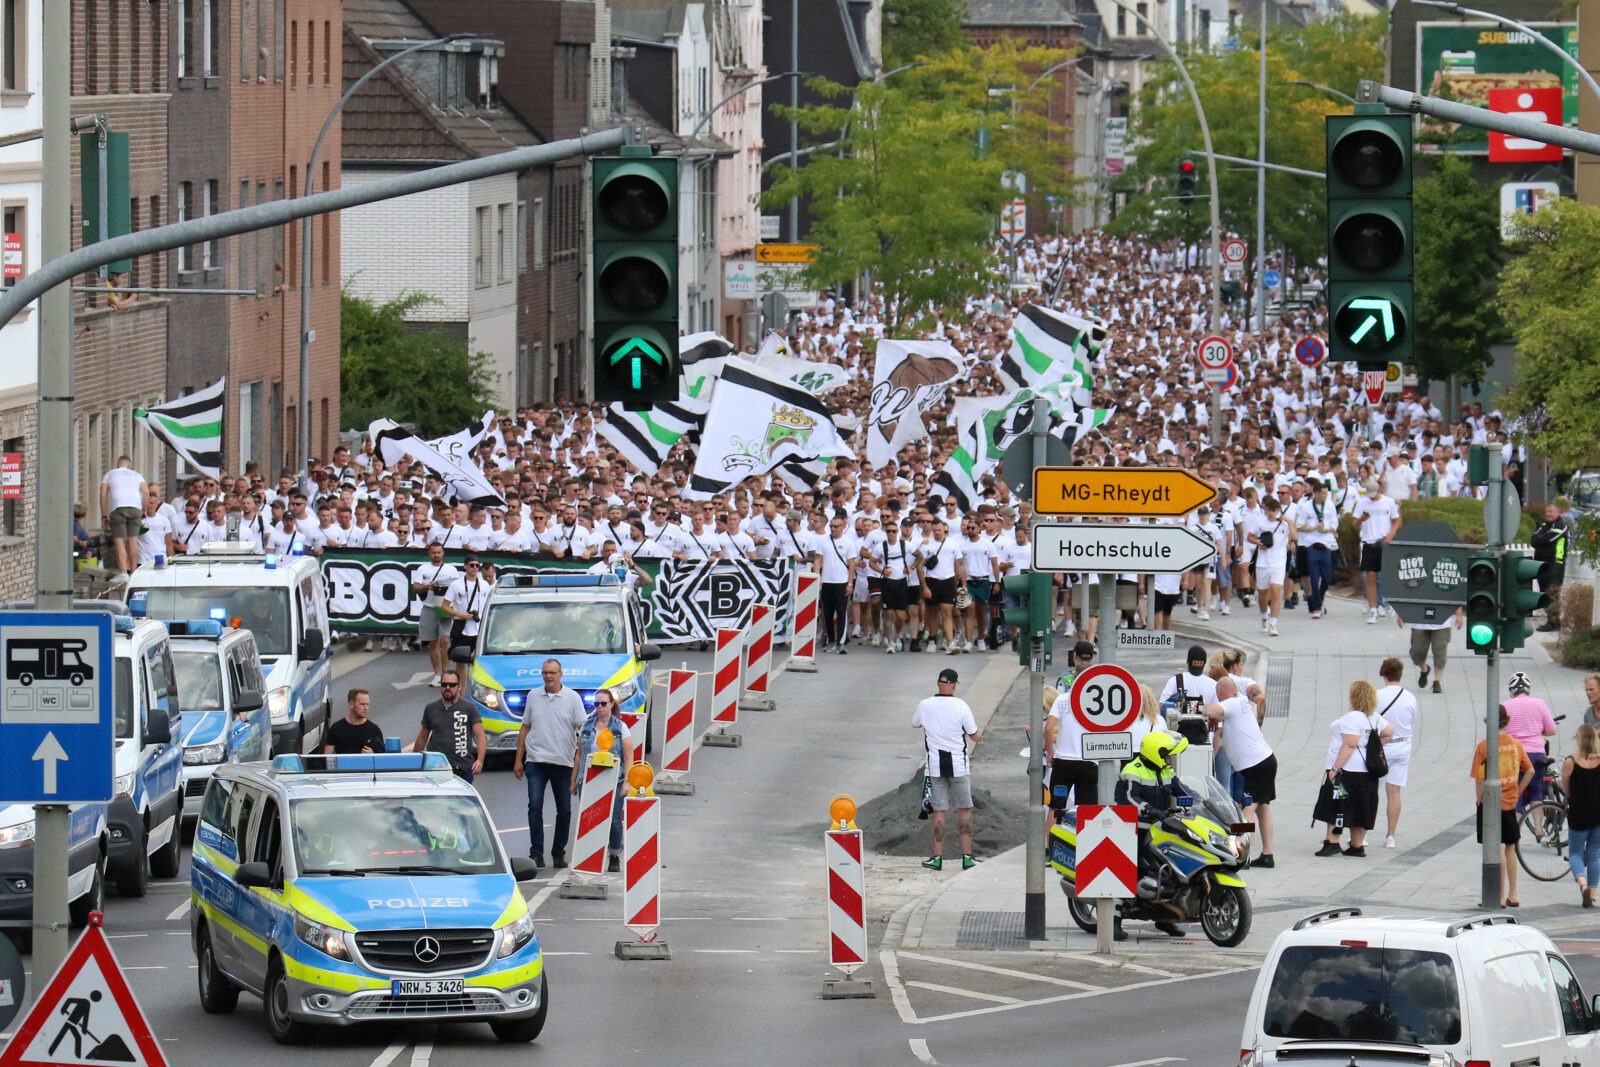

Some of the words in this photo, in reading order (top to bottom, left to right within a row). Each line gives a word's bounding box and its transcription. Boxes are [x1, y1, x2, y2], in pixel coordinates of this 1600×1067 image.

[1229, 246, 1242, 257] 30
[1206, 346, 1225, 361] 30
[1366, 371, 1384, 390] STOP
[1061, 484, 1171, 505] MG-Rheydt
[1059, 540, 1172, 557] Hochschule
[1400, 556, 1424, 569] RIOT
[1398, 567, 1428, 580] ULTRA
[1432, 568, 1461, 578] CULTURA
[1433, 576, 1459, 585] ULTRAS
[709, 573, 742, 618] B
[517, 668, 587, 676] POZEI
[1086, 684, 1126, 716] 30
[1086, 740, 1128, 752] Lärmschutz
[367, 897, 469, 910] POLIZEI
[400, 982, 420, 993] NRW
[425, 980, 462, 993] 5-3426
